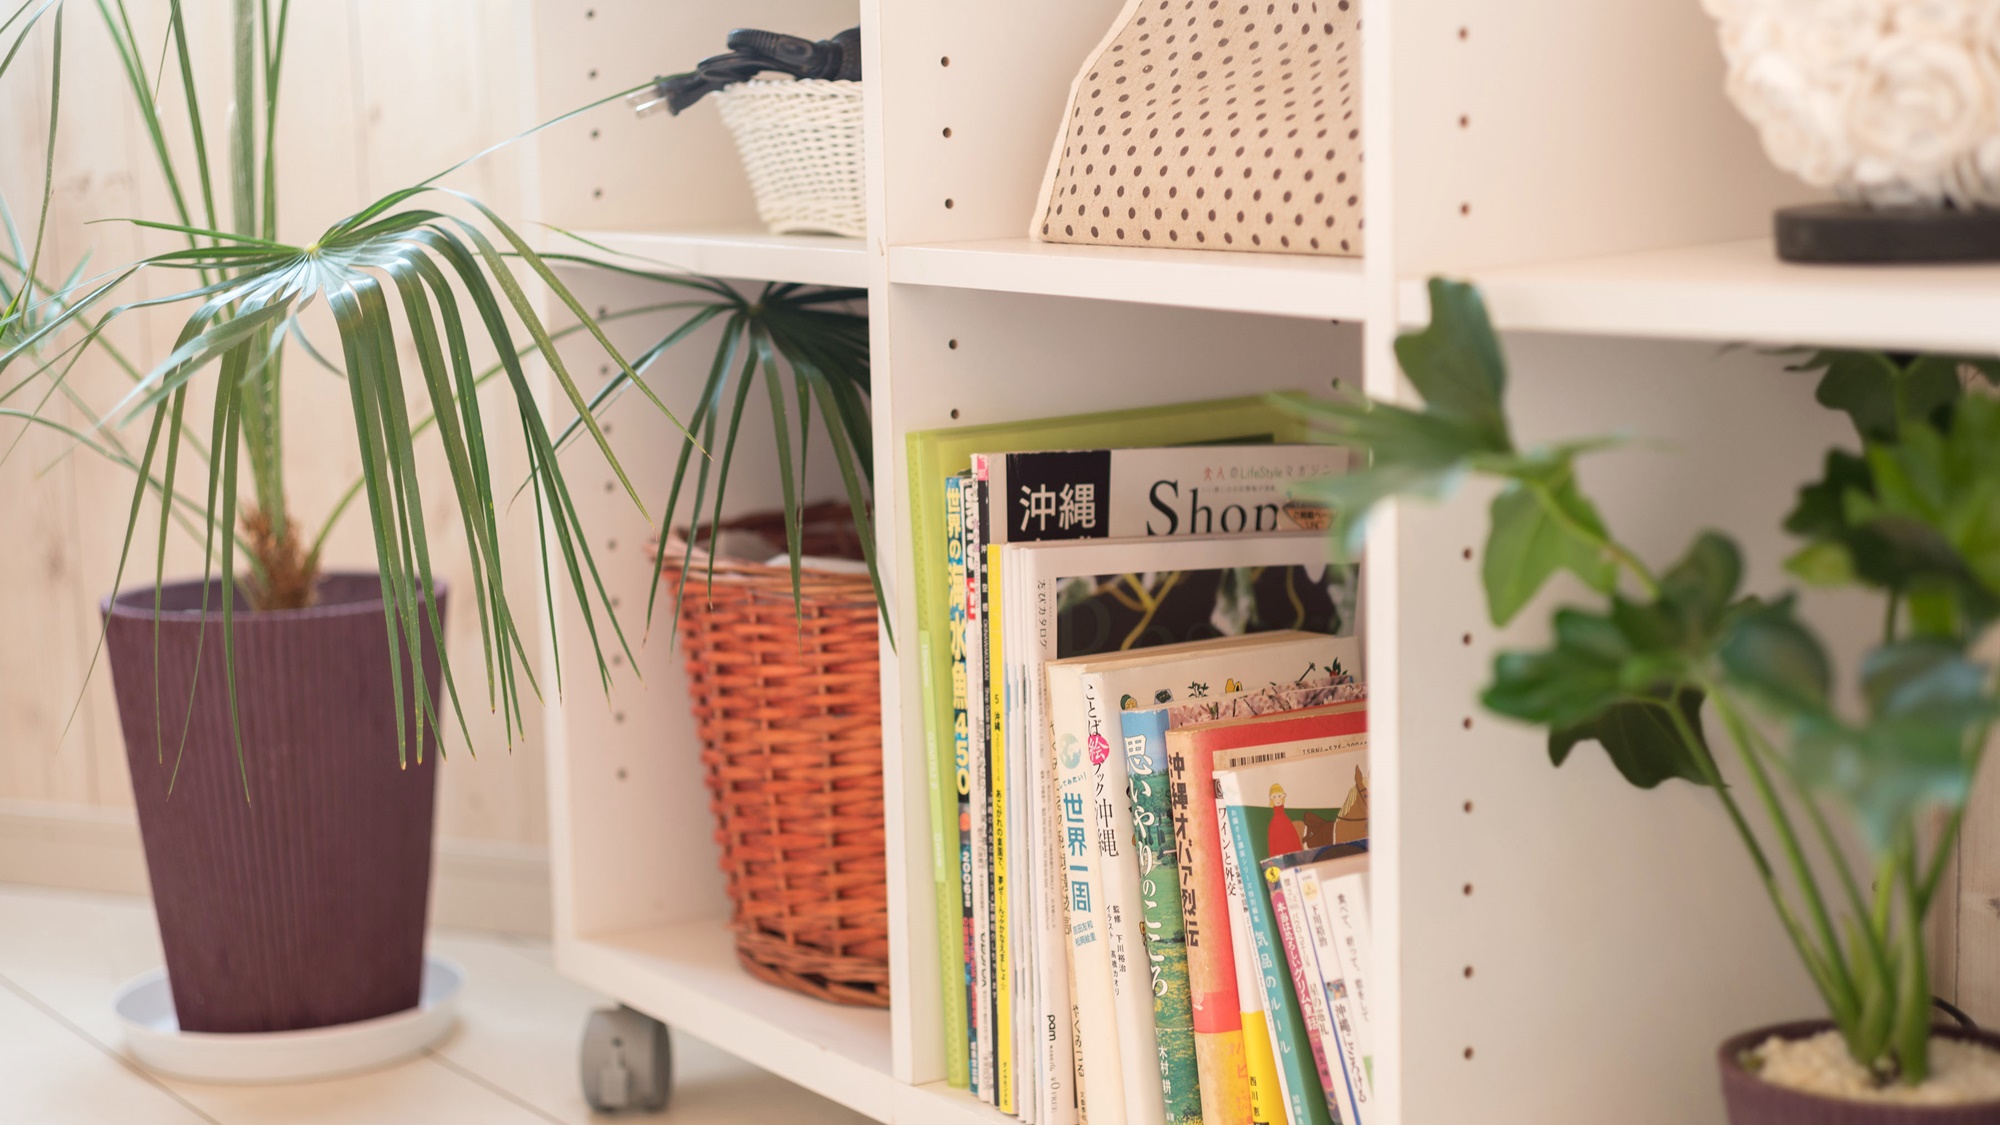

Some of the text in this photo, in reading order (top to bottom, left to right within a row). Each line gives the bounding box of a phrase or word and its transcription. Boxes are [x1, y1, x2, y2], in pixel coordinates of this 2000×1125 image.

[1019, 483, 1096, 532] 沖縄
[1063, 792, 1091, 913] 世界一周
[1094, 798, 1119, 858] 沖縄
[1168, 752, 1199, 947] 沖縄オバァ烈伝
[1218, 807, 1237, 896] ワインと外交
[1125, 734, 1168, 997] 思いやりのこころ
[1111, 950, 1120, 996] 高橋カオリ
[1113, 905, 1126, 973] 監修 下川裕治
[1277, 901, 1319, 1031] 本当は恐ろしいグリム童話
[1255, 931, 1291, 1054] 気品のルール
[1309, 983, 1329, 1036] 星の巡礼
[1047, 1014, 1056, 1041] pam
[1158, 1045, 1173, 1104] 木村耕一
